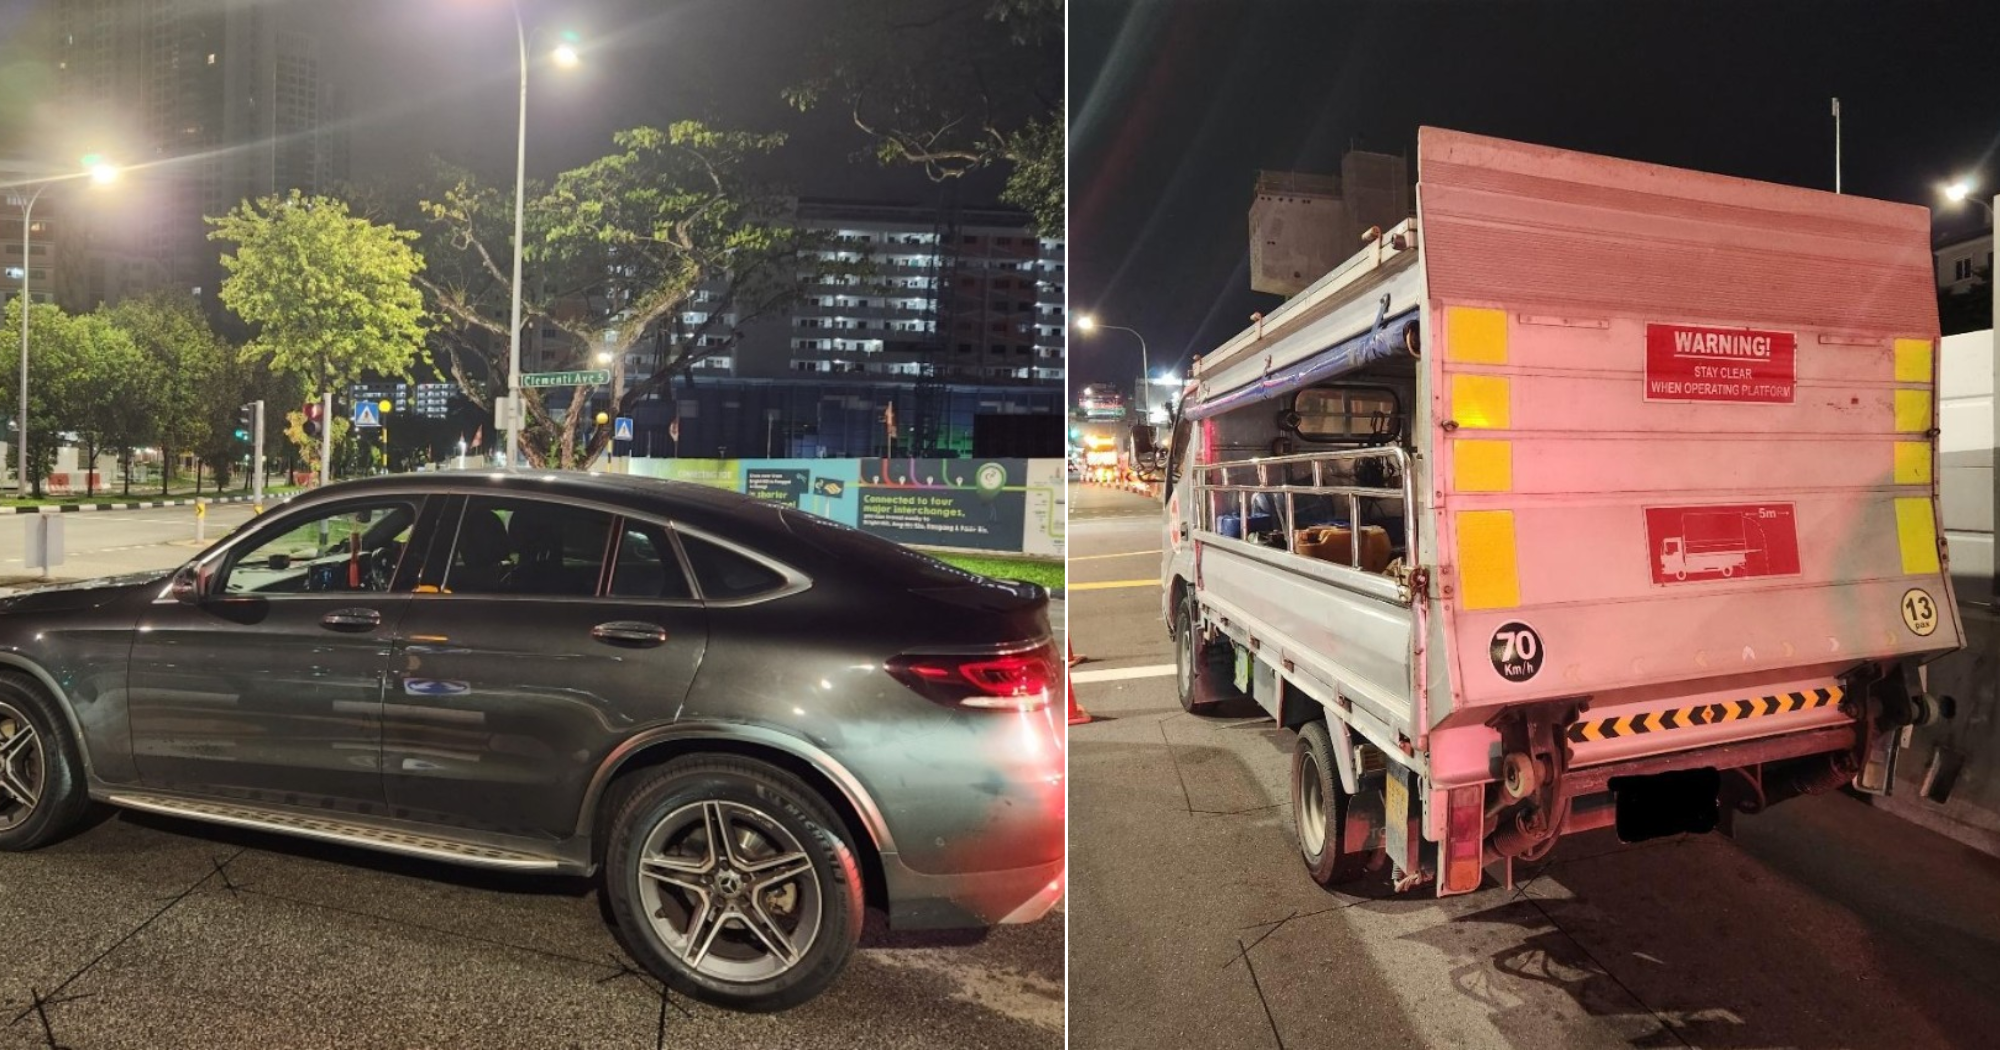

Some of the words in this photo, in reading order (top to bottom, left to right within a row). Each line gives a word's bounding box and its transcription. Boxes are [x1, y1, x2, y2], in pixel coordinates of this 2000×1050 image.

[1674, 331, 1771, 357] WARNING!
[524, 375, 571, 386] Clementi
[573, 373, 594, 383] Ave
[1694, 366, 1718, 378] STAY
[1720, 367, 1752, 380] CLEAR
[1651, 380, 1682, 394] WHEN
[1684, 381, 1740, 396] OPERATING
[1741, 384, 1791, 398] PLATFORM
[863, 494, 915, 505] Connected
[917, 496, 928, 505] to
[931, 496, 954, 506] four
[863, 504, 892, 515] major
[893, 504, 966, 518] interchanges.
[1758, 508, 1777, 519] 5m
[1905, 596, 1933, 621] 13
[1915, 622, 1931, 631] pax
[1496, 630, 1536, 663] 70
[1504, 661, 1534, 676] Km/h
[785, 803, 847, 884] MICHELIN
